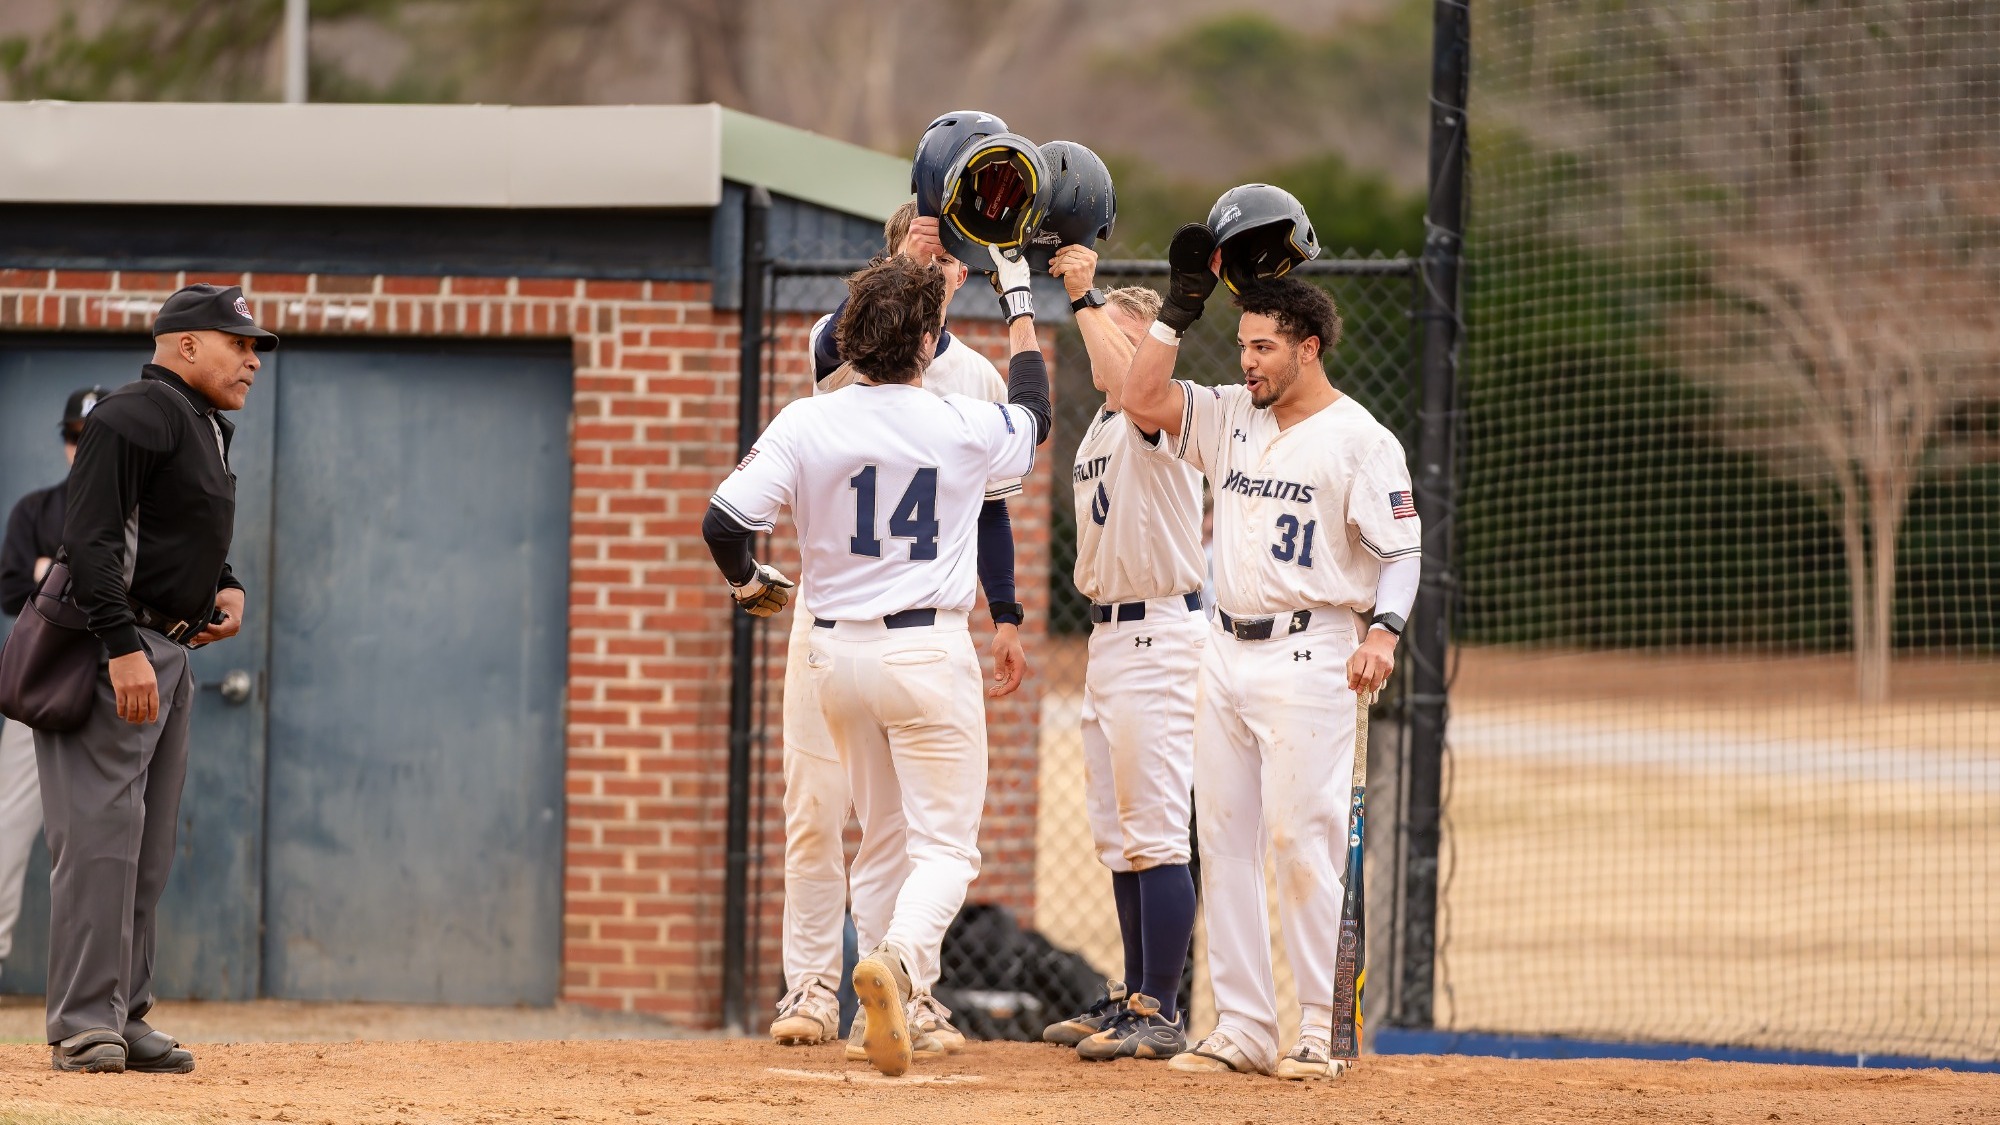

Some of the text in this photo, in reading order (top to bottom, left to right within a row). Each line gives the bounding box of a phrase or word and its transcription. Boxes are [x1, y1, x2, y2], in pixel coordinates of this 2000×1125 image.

[849, 464, 940, 561] 14
[1222, 469, 1317, 504] MARLINS
[1271, 513, 1317, 568] 31
